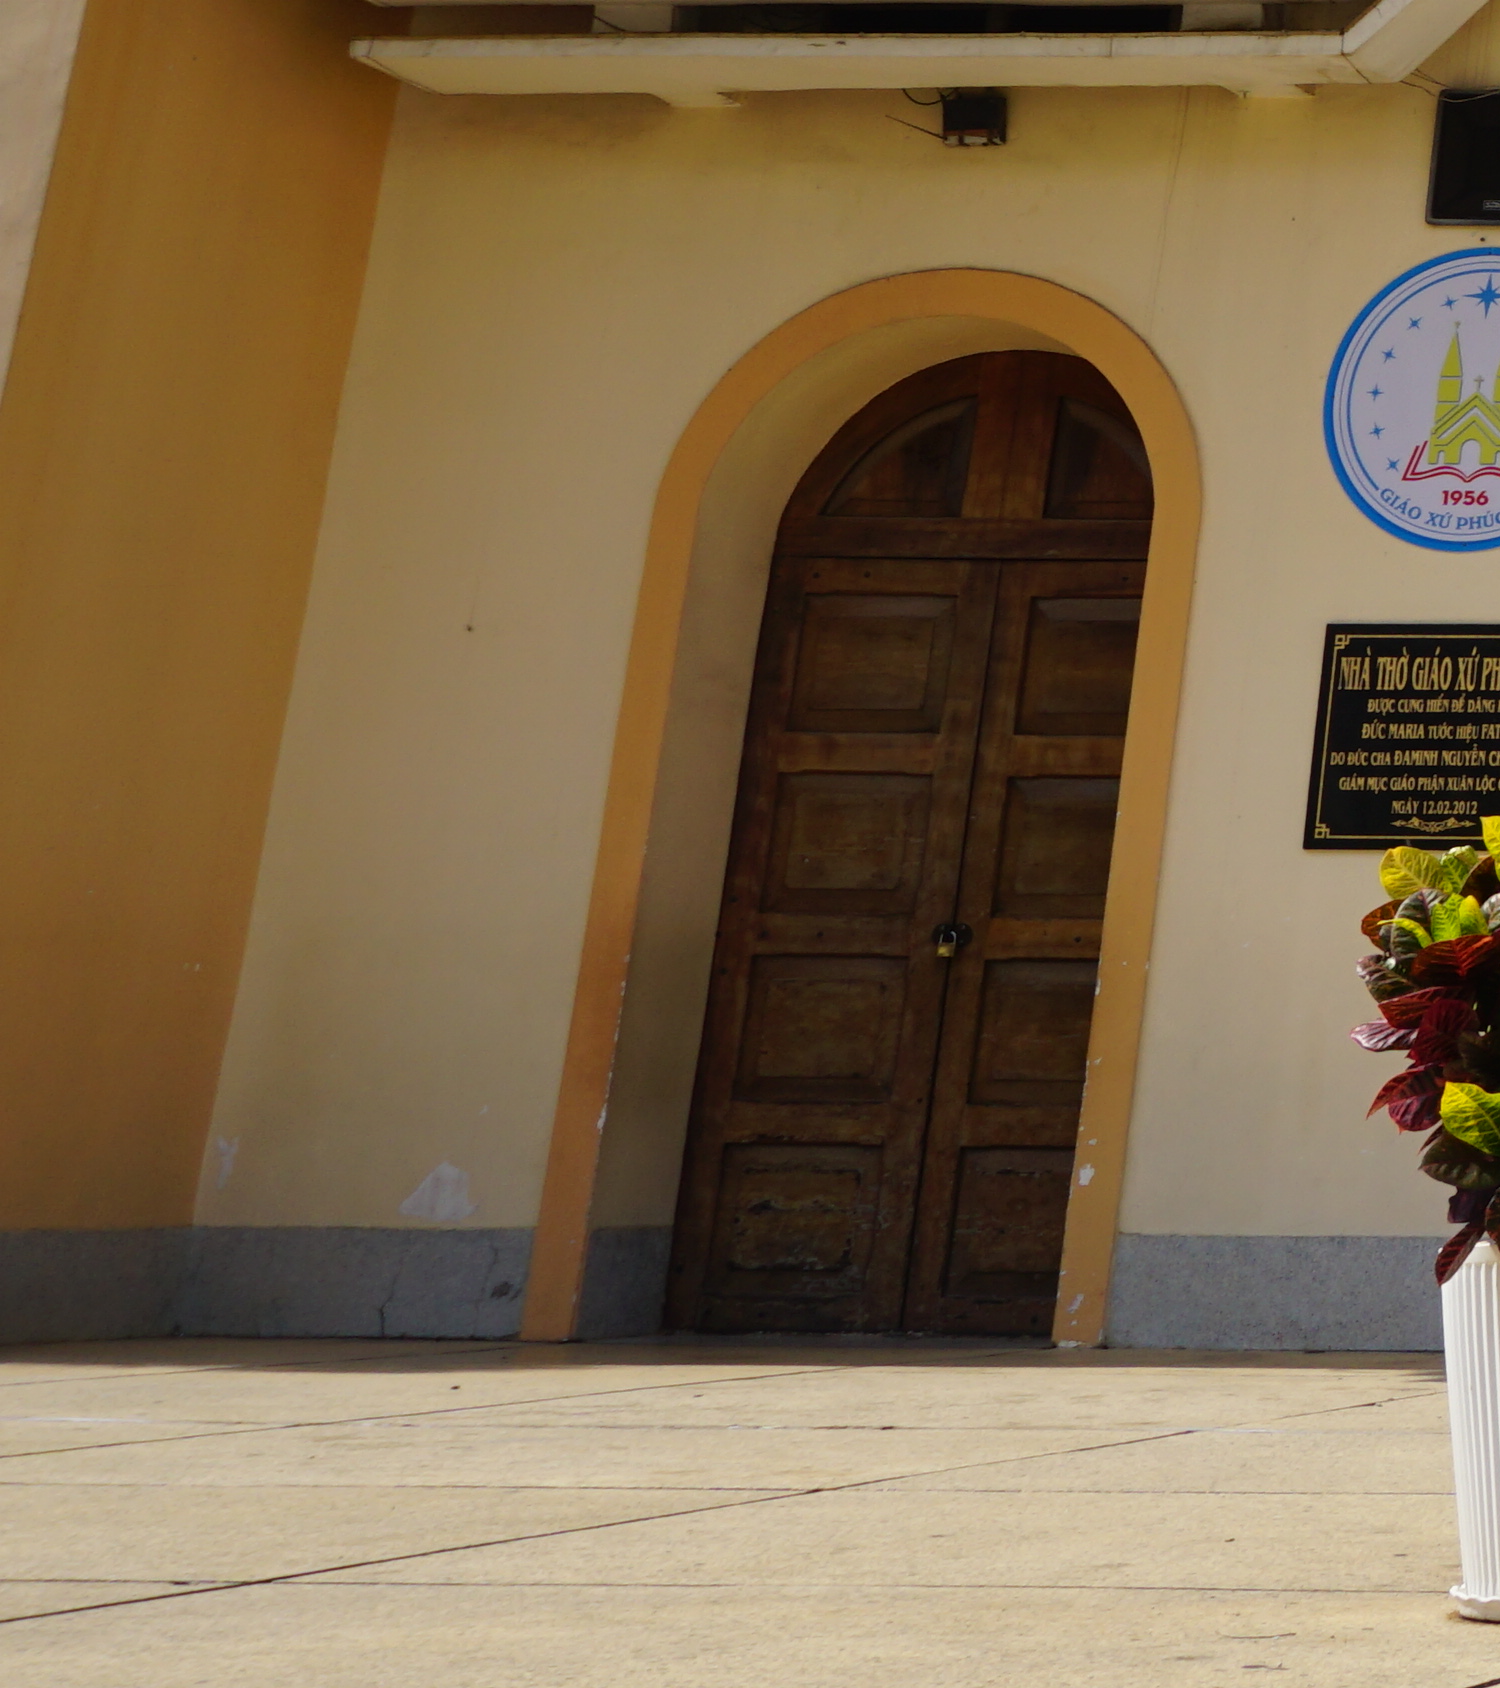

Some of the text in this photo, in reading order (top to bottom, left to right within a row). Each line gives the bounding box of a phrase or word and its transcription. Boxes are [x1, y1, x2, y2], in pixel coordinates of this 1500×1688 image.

[1379, 487, 1422, 520] GIÁO
[1424, 510, 1453, 529] XỨ
[1441, 490, 1489, 506] 1956
[1338, 645, 1372, 690] NHÀ
[1376, 646, 1410, 691] THỜ
[1412, 646, 1453, 691] GIÁO
[1454, 646, 1481, 692] XỨ
[1361, 718, 1386, 740] ĐỨC
[1388, 723, 1425, 740] MARIA
[1455, 723, 1480, 744] HIỆU
[1330, 751, 1345, 766] DO
[1347, 747, 1368, 766] ĐỨC
[1370, 751, 1391, 766] CHA
[1393, 750, 1439, 766] ĐAMINH
[1441, 743, 1486, 766] NGUYỄN
[1338, 772, 1365, 791] GIÁM
[1366, 777, 1388, 795] MỤC
[1390, 773, 1416, 791] GIÁO
[1417, 774, 1445, 795] PHẬN
[1446, 774, 1474, 791] XUÂN
[1475, 774, 1496, 795] LỘC
[1390, 796, 1478, 815] NGÀY 12.02.2012
